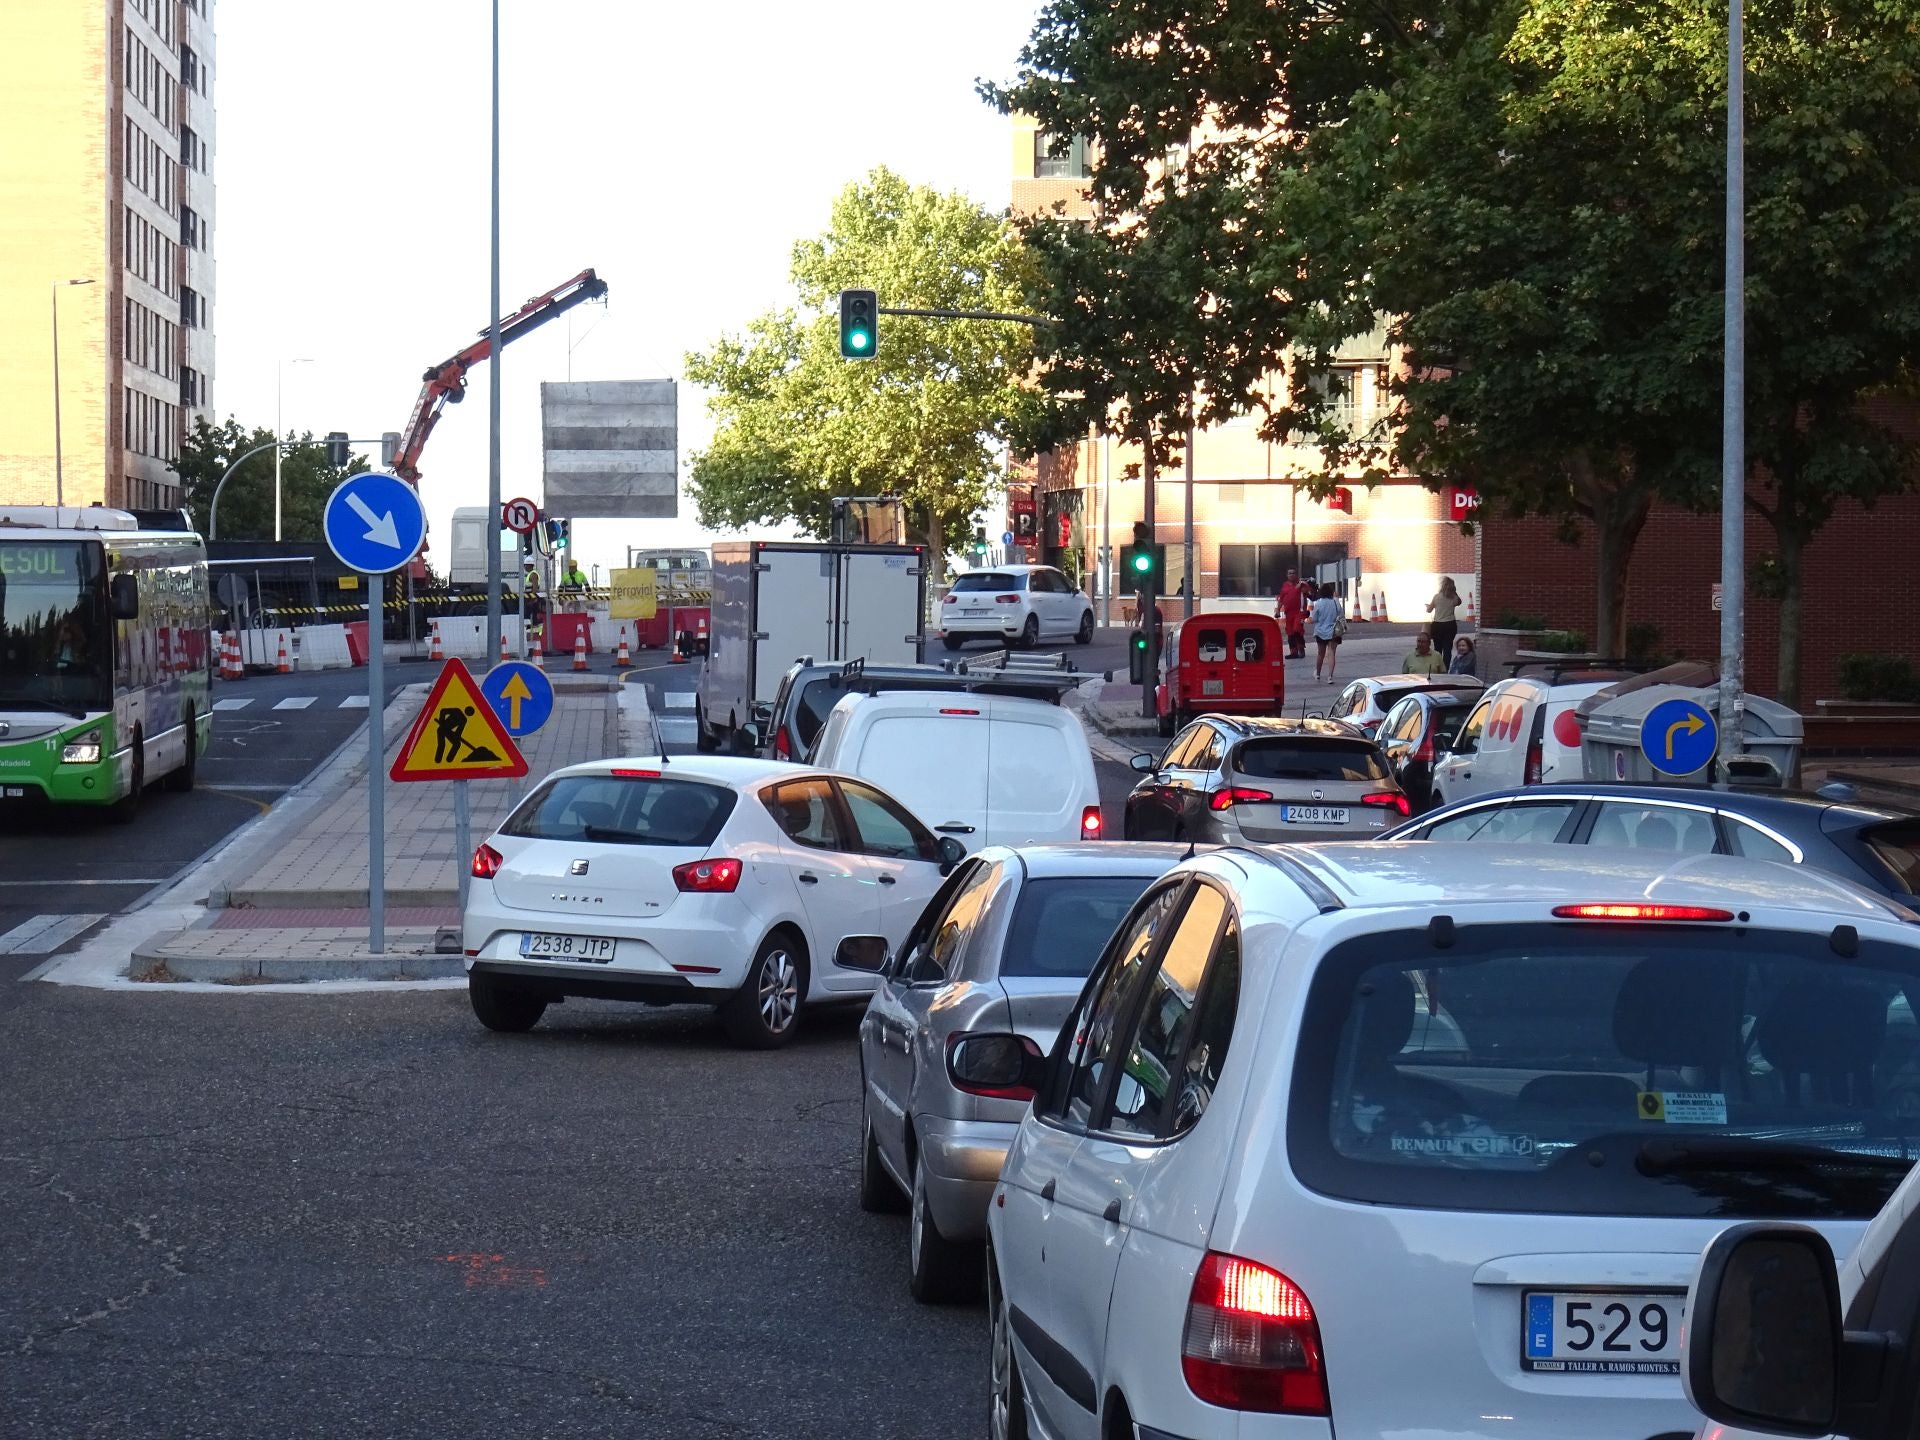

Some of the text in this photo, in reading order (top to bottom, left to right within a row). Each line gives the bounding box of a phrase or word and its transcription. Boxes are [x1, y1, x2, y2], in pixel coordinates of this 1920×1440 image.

[44, 739, 57, 751] 11
[1289, 807, 1345, 820] 2408 KMP
[551, 893, 602, 903] IBIZA
[531, 935, 610, 956] 2538 JTP
[1566, 1302, 1685, 1352] 529
[1535, 1333, 1547, 1348] E
[1568, 1362, 1597, 1371] TALLER
[1609, 1362, 1636, 1372] RAMOS
